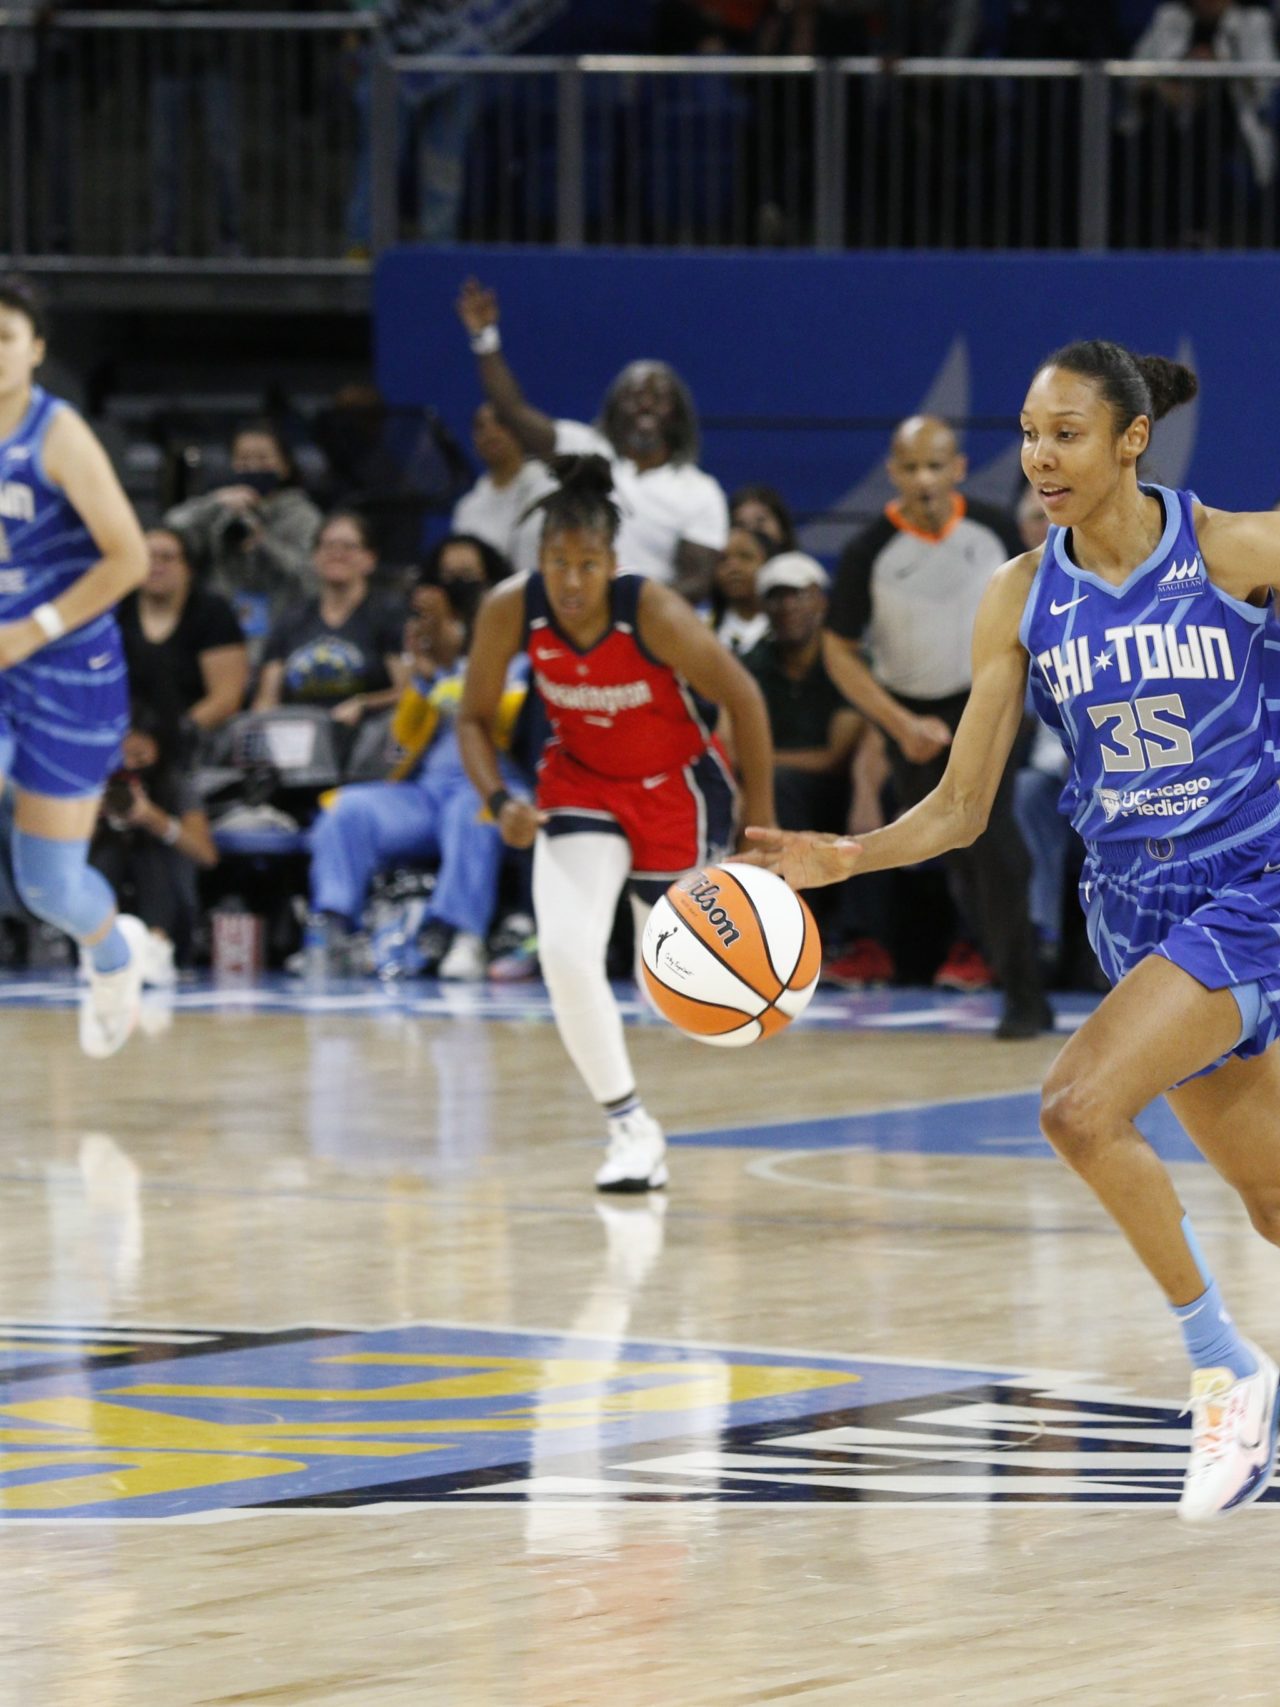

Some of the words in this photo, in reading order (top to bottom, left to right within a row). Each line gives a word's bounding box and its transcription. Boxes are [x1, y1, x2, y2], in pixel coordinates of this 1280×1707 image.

[1104, 623, 1236, 684] TOWN
[1086, 692, 1194, 773] 35
[1122, 776, 1211, 808] UChicago
